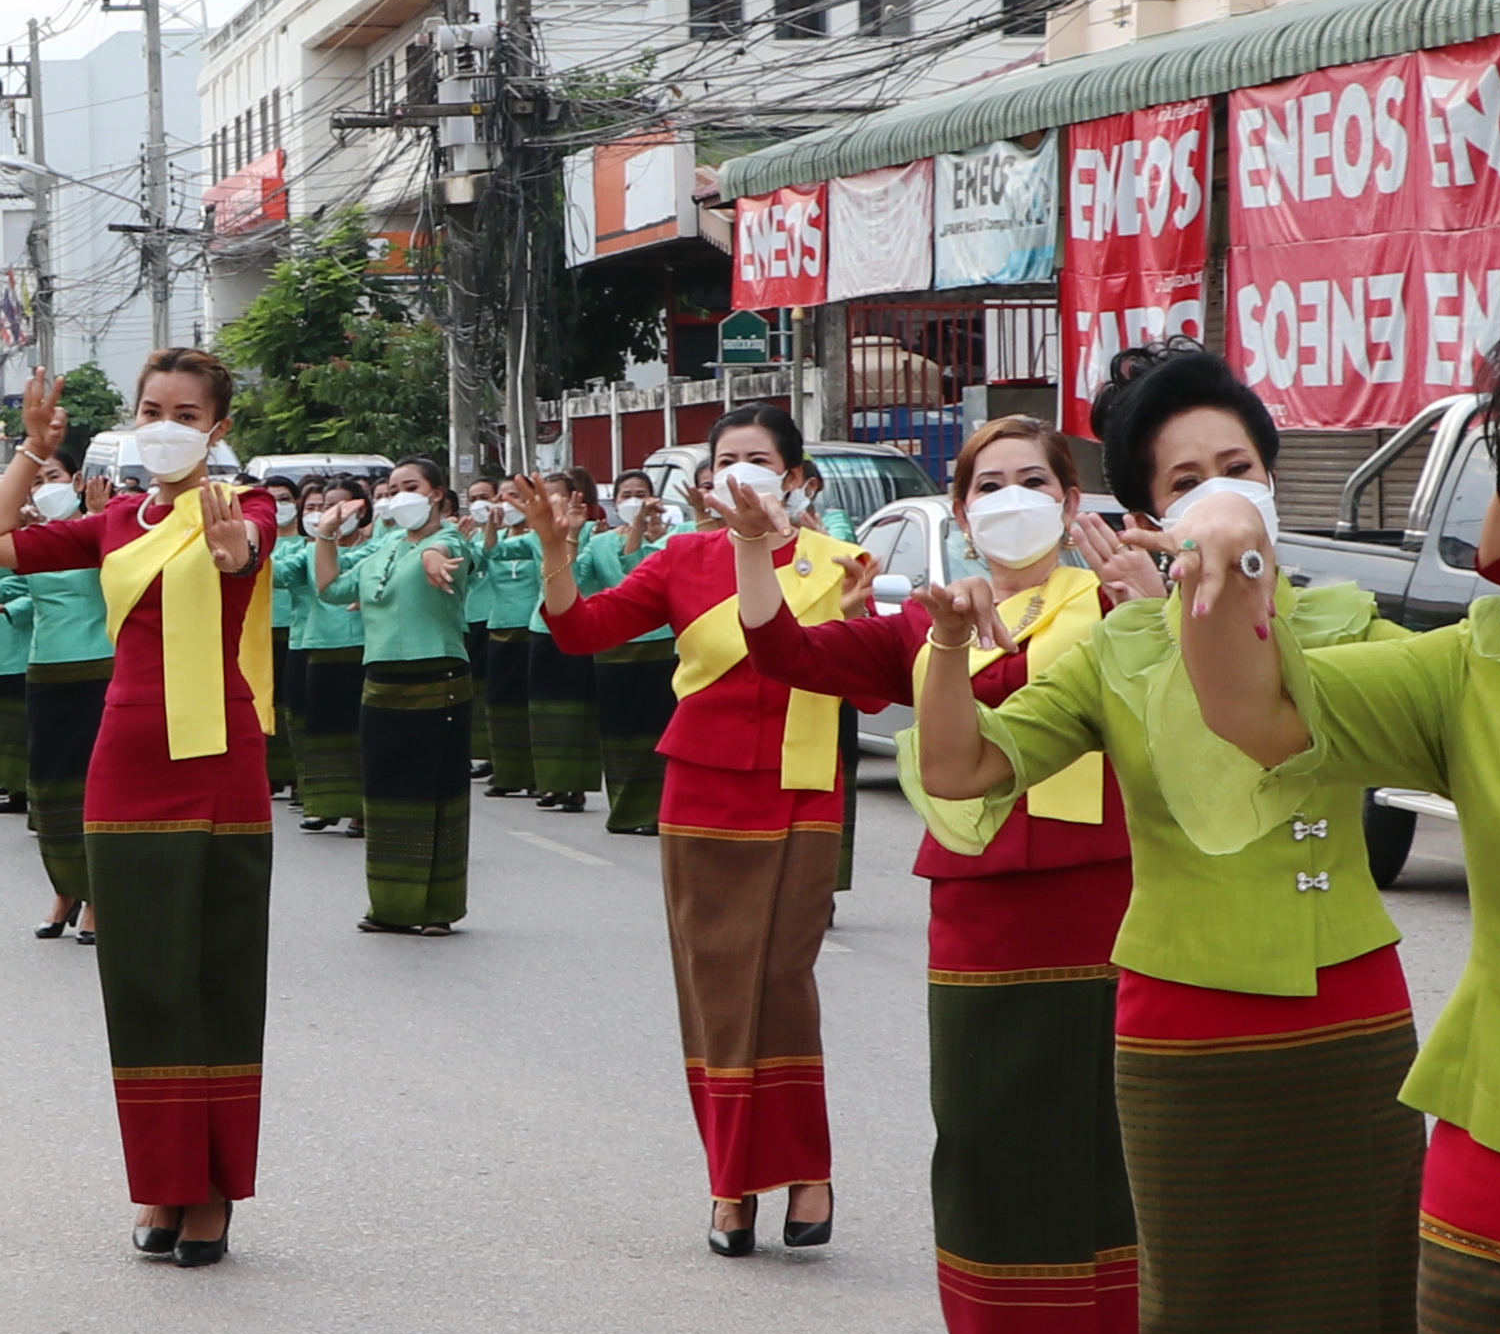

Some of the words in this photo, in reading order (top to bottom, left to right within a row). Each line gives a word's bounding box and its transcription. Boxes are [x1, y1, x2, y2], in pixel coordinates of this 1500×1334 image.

[1069, 128, 1202, 242] ENEOS
[1237, 75, 1408, 208] ENEOS
[739, 199, 822, 283] ENEOS
